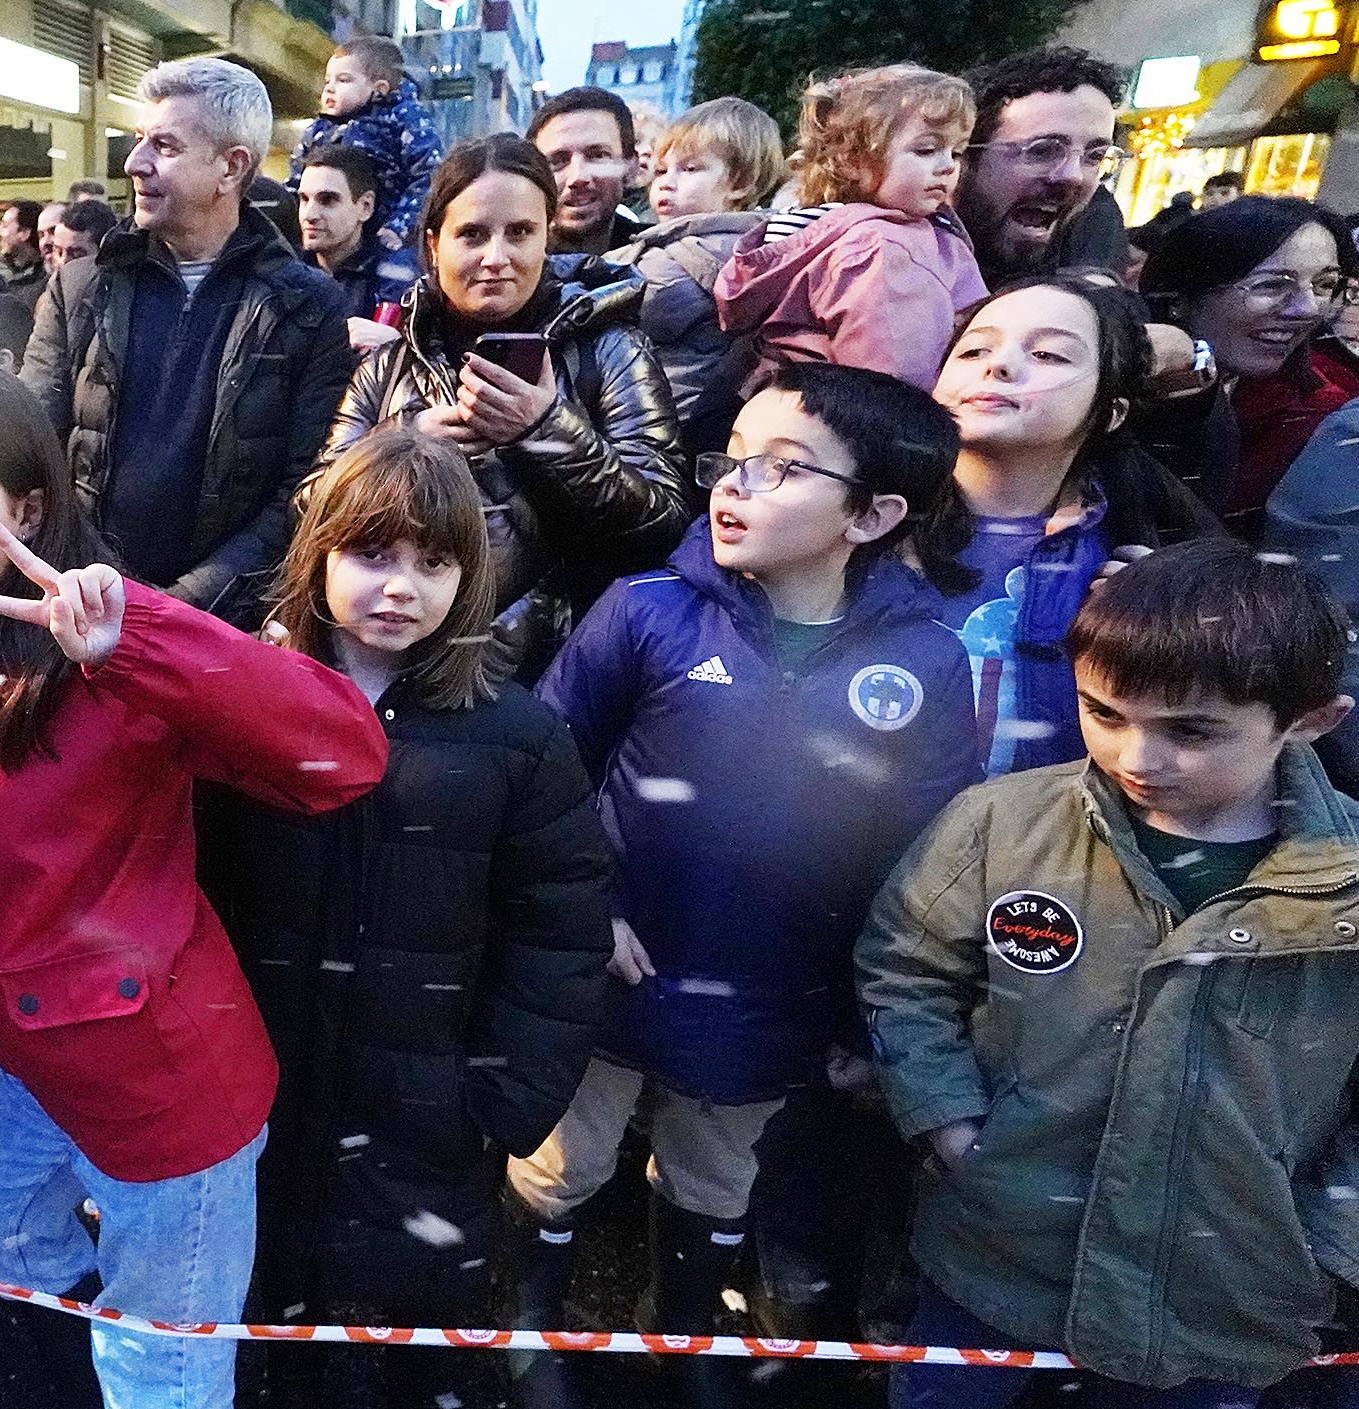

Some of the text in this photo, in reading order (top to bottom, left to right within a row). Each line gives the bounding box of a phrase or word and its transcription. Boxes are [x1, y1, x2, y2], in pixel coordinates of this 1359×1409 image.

[687, 670, 733, 685] adidas
[1006, 901, 1061, 923] LETS BE
[993, 917, 1077, 947] Everyday
[1004, 938, 1060, 963] AWESOME
